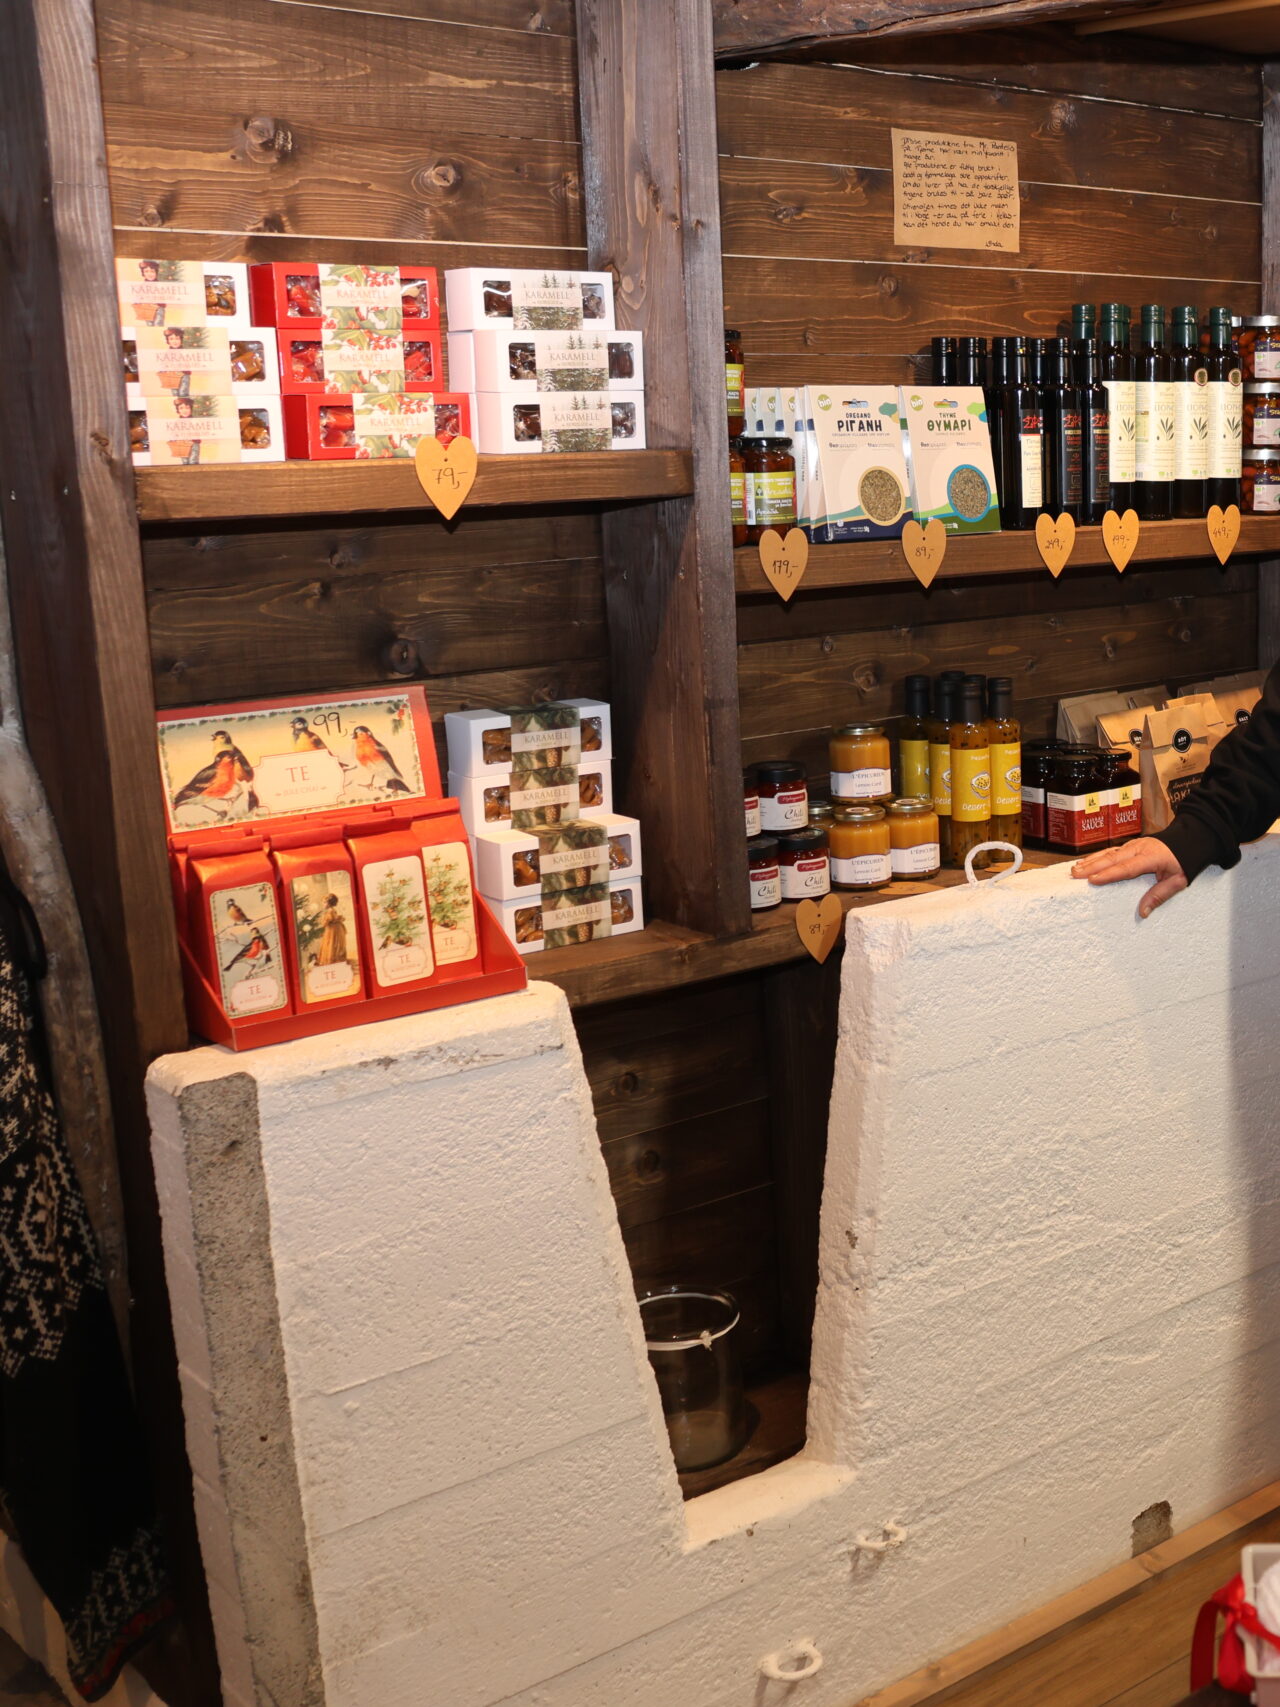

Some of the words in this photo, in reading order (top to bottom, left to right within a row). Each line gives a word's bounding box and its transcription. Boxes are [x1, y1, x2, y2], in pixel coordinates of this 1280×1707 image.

[130, 285, 190, 296] KARAMELL
[525, 290, 570, 300] KARAMELL
[155, 352, 215, 362] KARAMELL
[549, 352, 597, 361] KARAMELL
[554, 412, 601, 422] KARAMELL
[165, 420, 224, 431] KARAMELL
[837, 419, 883, 432] ΡΙΓΑΝΗ
[927, 419, 972, 432] ΘΥΜΑΡΙ
[432, 467, 468, 490] 79,-
[914, 545, 936, 560] 89,-
[772, 559, 799, 578] 179,-
[312, 711, 358, 738] 99,-
[523, 731, 569, 744] KARAMELL
[285, 765, 311, 783] TE
[522, 788, 568, 801] KARAMELL
[996, 796, 1020, 805] Dessert
[962, 803, 987, 812] Dessert
[784, 808, 804, 820] Chili
[1115, 814, 1137, 825] SAUCE
[746, 817, 757, 825] hili
[1081, 820, 1105, 832] SAUCE
[552, 850, 598, 865] KARAMELL
[804, 875, 824, 887] Chili
[757, 885, 777, 897] Chili
[554, 905, 600, 920] KARAMELL
[809, 923, 832, 935] 89,-
[442, 936, 456, 947] TE
[398, 953, 411, 965] TE
[323, 970, 337, 981] TE
[247, 984, 262, 996] TE
